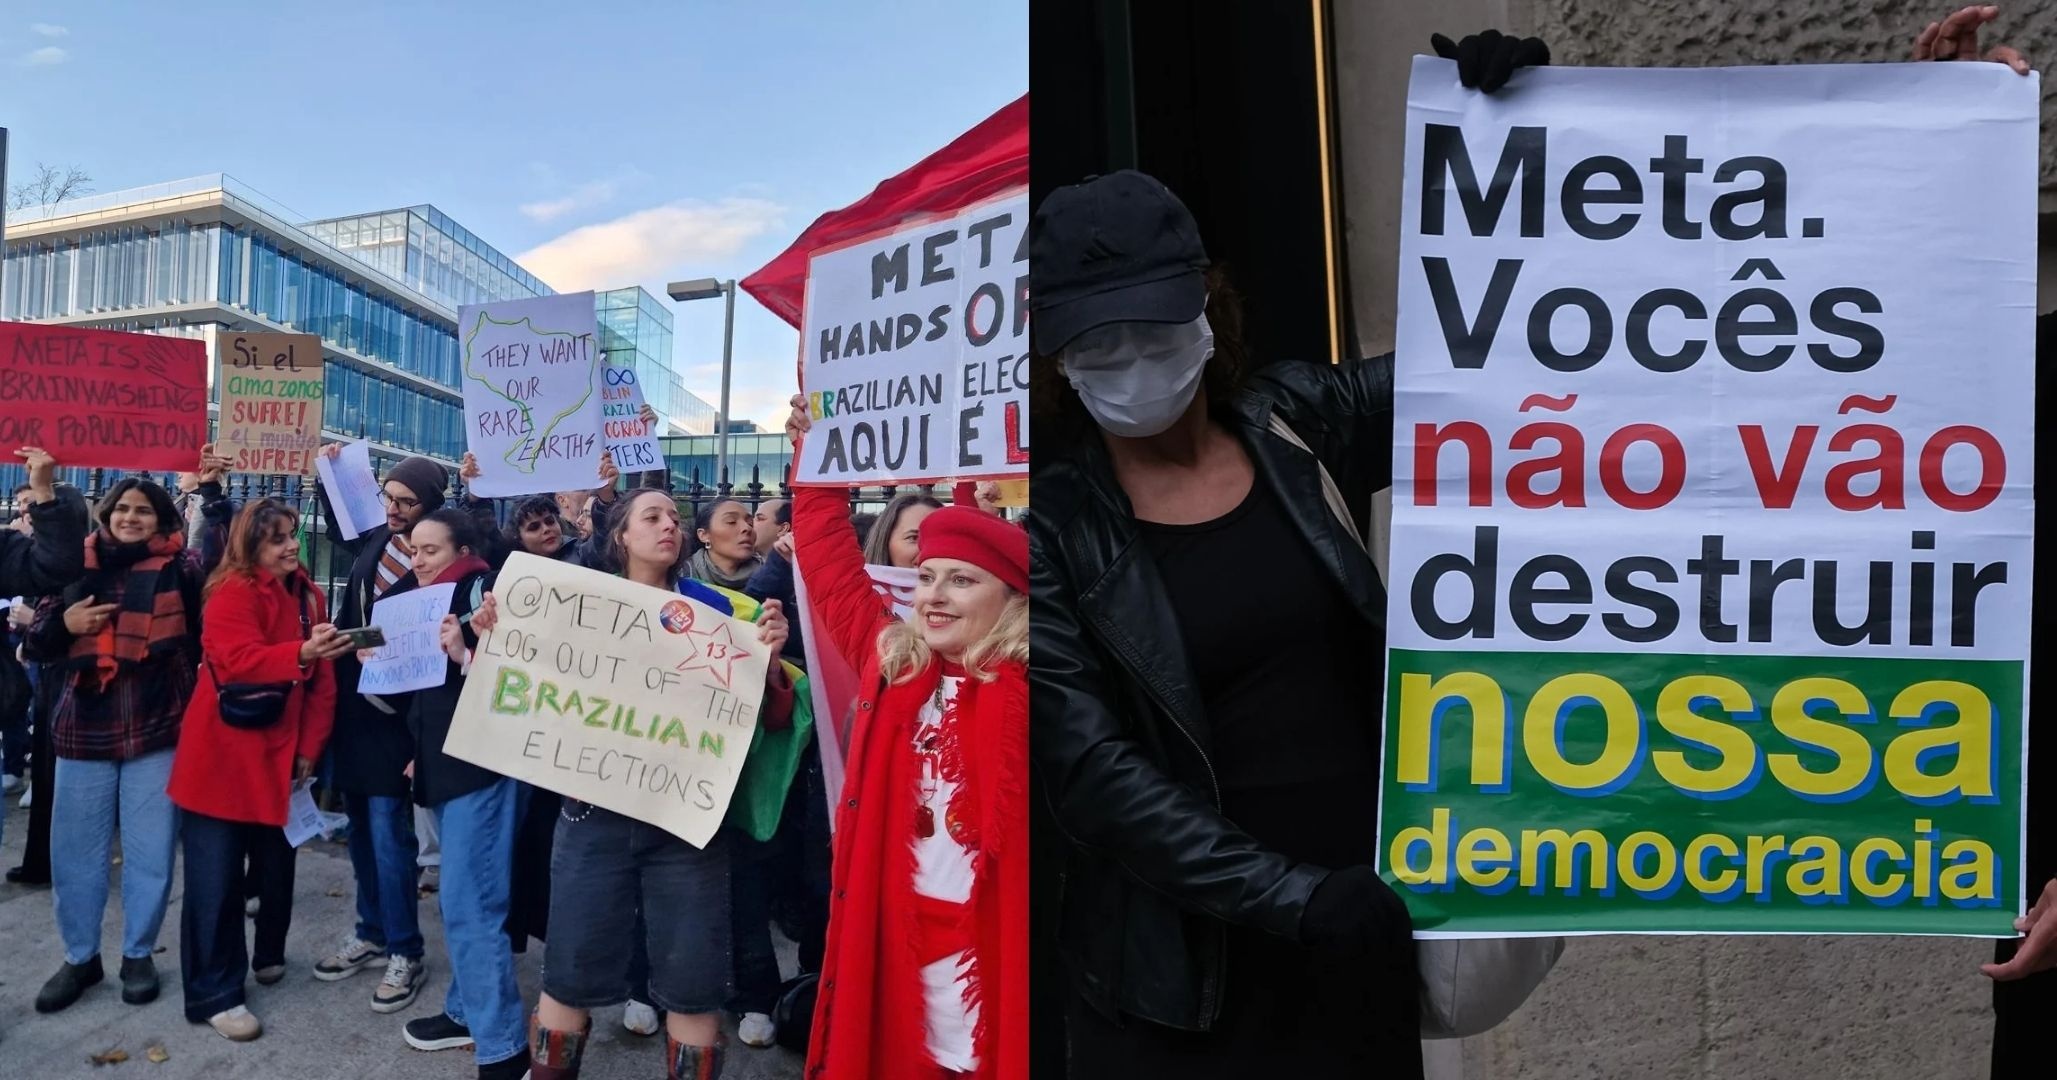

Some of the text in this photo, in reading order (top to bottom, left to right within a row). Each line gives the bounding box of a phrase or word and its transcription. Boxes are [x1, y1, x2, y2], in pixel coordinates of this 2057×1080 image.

[1420, 122, 1825, 241] Meta.
[819, 304, 952, 363] HANDS
[1420, 256, 1886, 373] Vocês
[12, 333, 141, 369] META IS
[233, 337, 302, 373] Si el
[481, 332, 593, 368] THEY WANT
[0, 367, 200, 413] BRAINWASHING
[506, 375, 542, 401] OUR
[809, 372, 943, 422] BRAZILIAN
[0, 413, 198, 451] OUR POPULATION
[230, 427, 249, 447] el
[232, 399, 307, 435] SUFRE!
[478, 407, 534, 438] RARE
[817, 413, 931, 475] AQUI
[958, 400, 985, 468] É
[236, 447, 310, 476] SUFRE!
[605, 441, 655, 468] TERS
[1413, 393, 2007, 512] não vão
[506, 575, 652, 643] @META
[1410, 526, 2008, 647] destruir
[705, 641, 728, 660] 13
[485, 629, 753, 729] LOG OUT OF THE
[490, 664, 726, 760] BRAZILIAN
[1397, 671, 2000, 804] nossa
[523, 730, 715, 811] ELECTIONS
[1389, 807, 2000, 908] democracia
